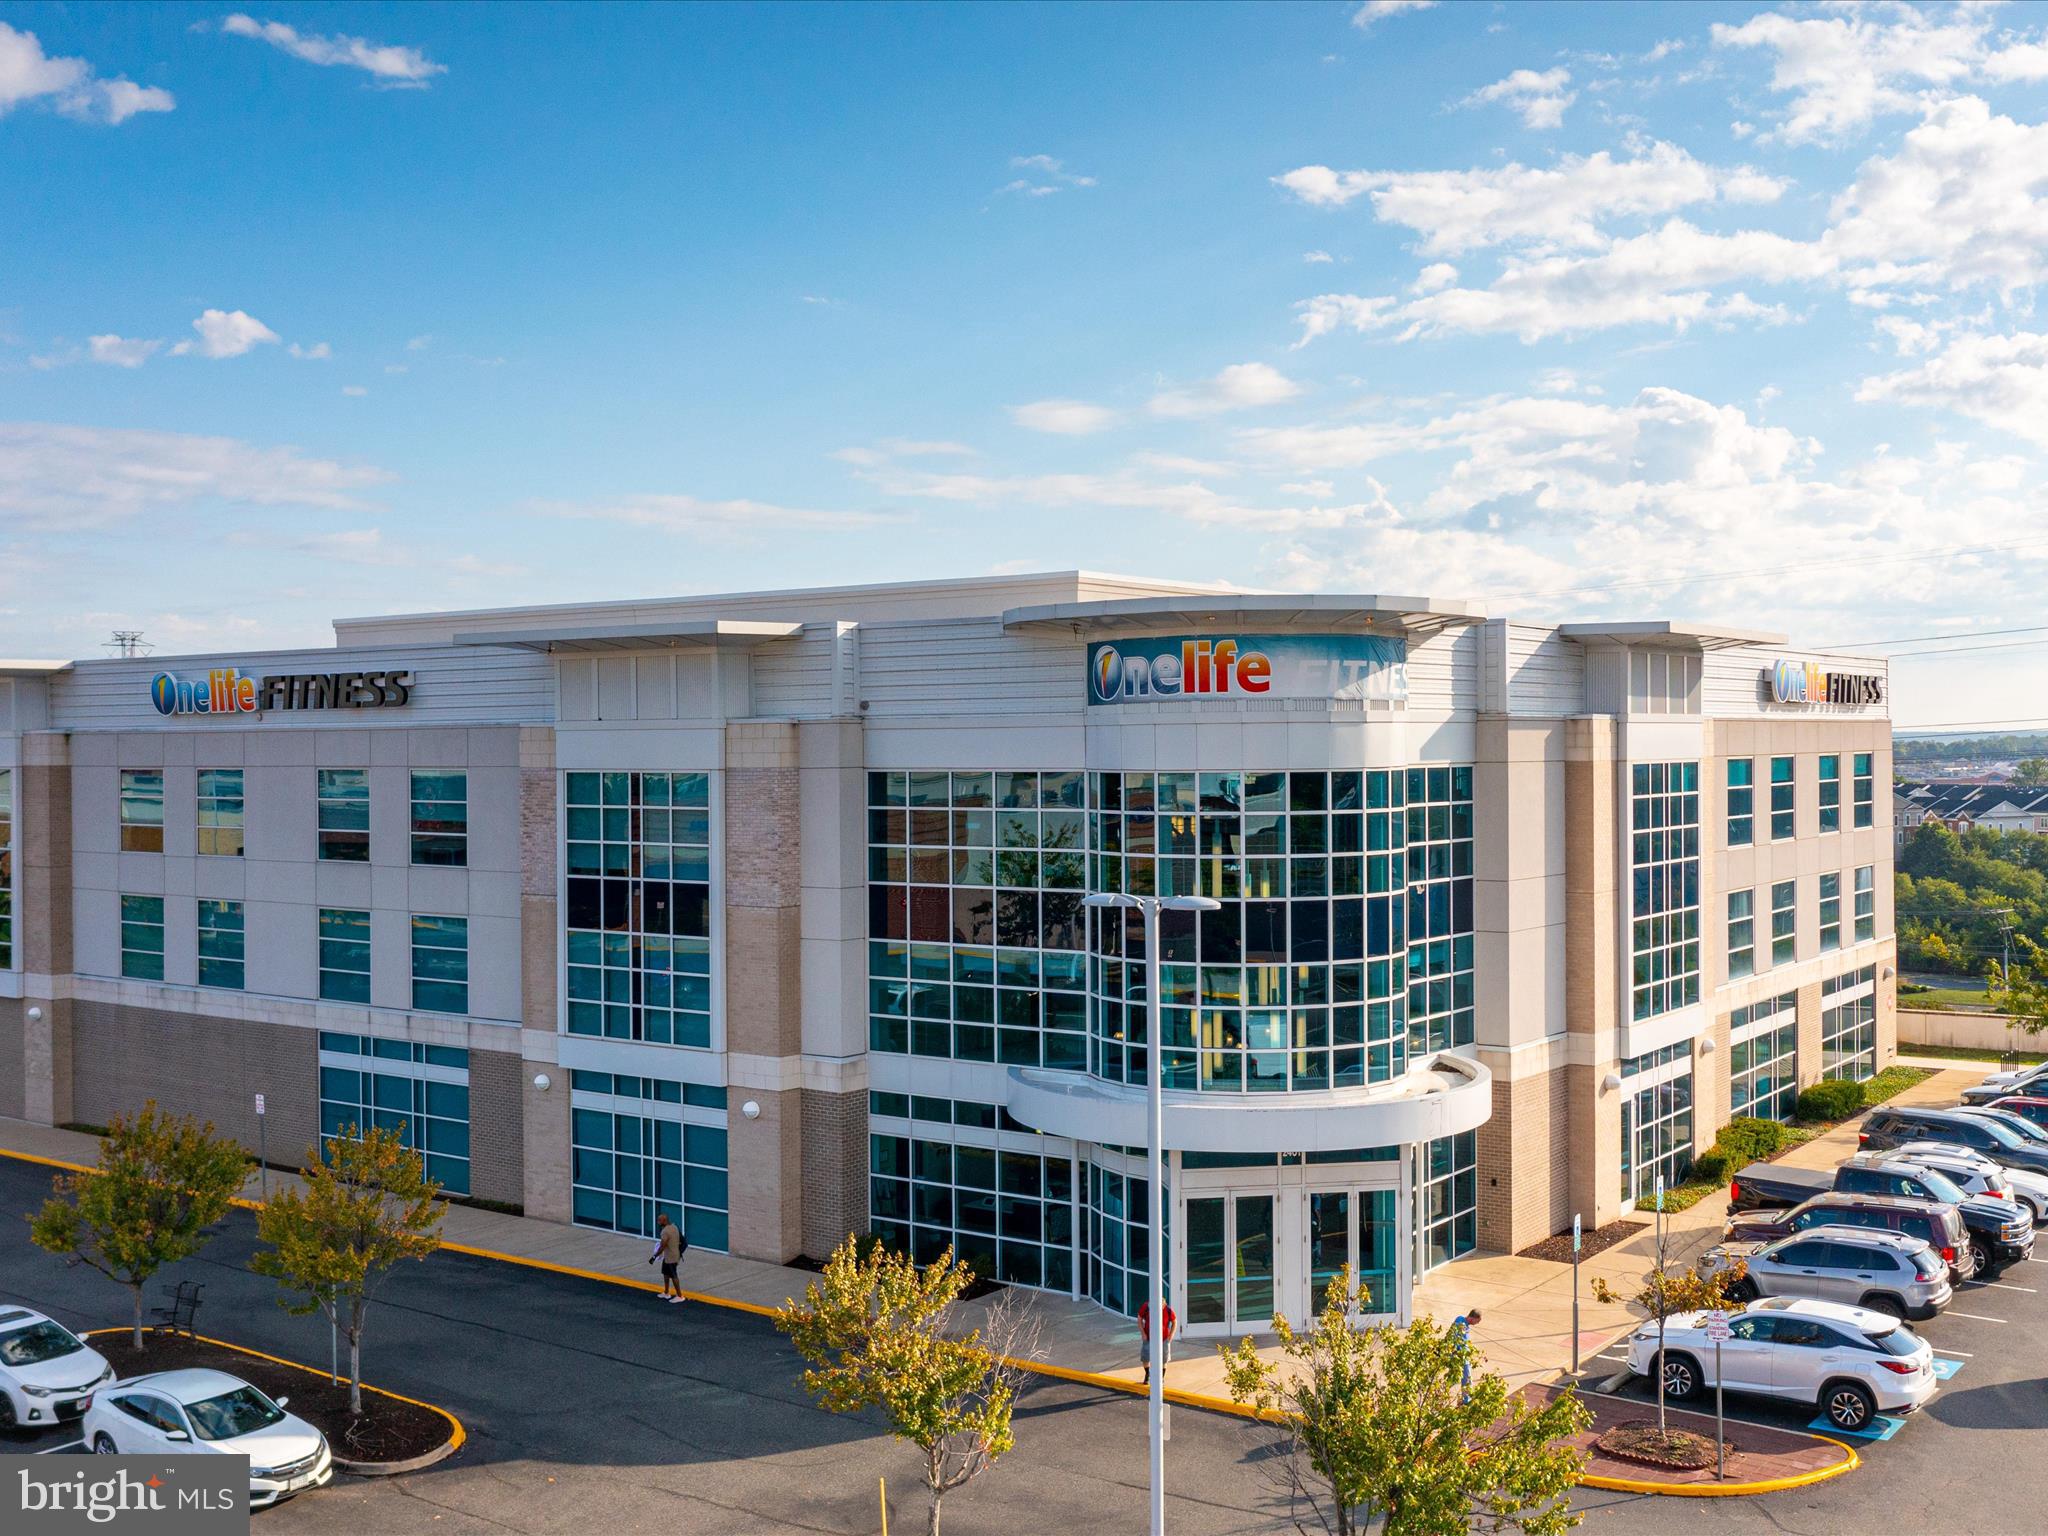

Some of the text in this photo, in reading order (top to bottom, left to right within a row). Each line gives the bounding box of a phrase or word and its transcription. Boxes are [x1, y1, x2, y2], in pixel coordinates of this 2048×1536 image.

[151, 667, 409, 717] Onelife FITNESS
[1092, 639, 1272, 701] Onelife
[1775, 657, 1882, 704] Onelife FITNESS
